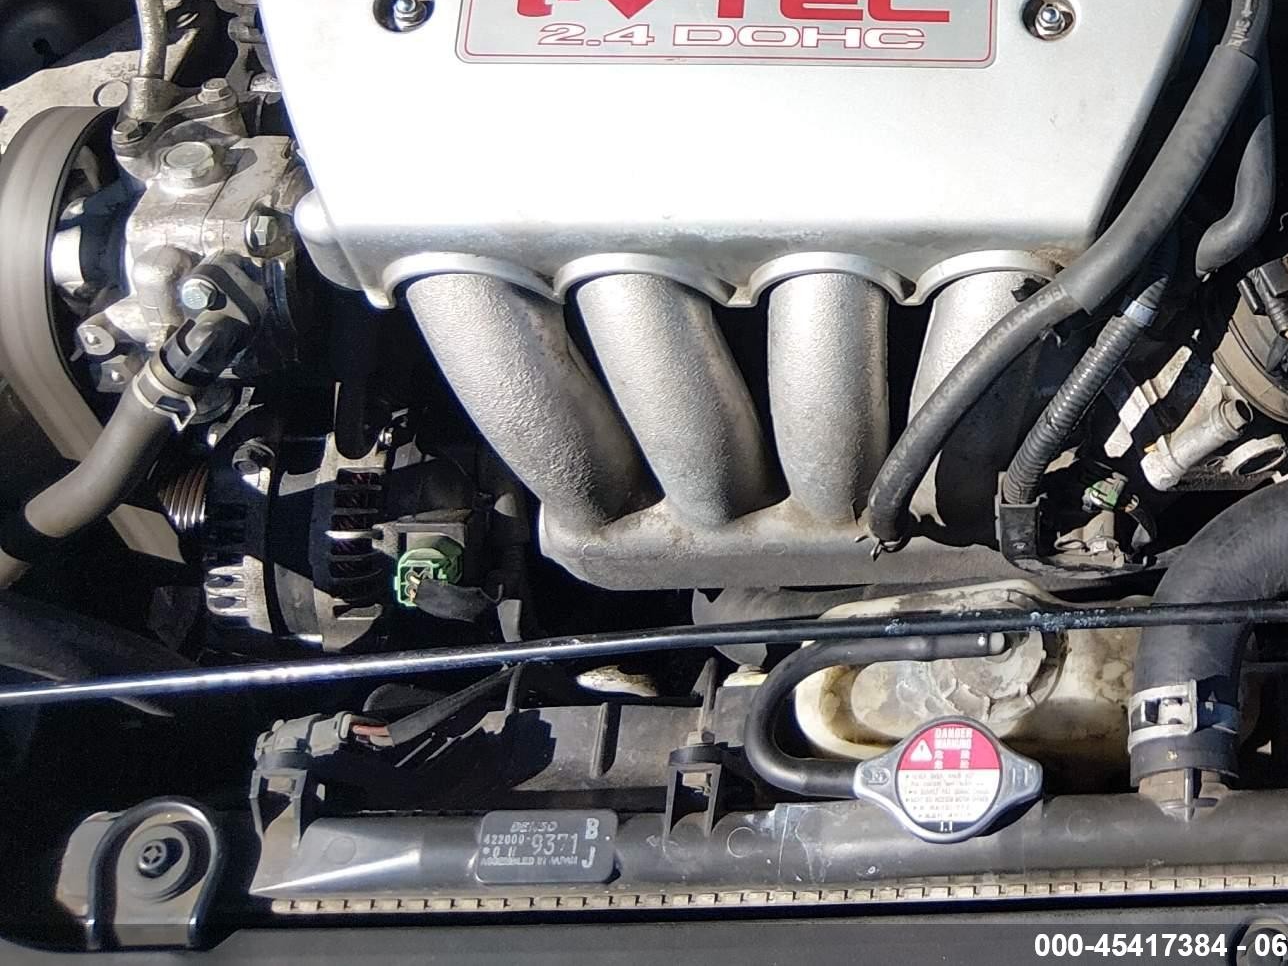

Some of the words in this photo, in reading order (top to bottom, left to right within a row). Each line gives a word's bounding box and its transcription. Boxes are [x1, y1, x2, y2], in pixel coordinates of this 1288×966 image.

[538, 23, 655, 47] 2.4
[672, 24, 925, 49] DOHC
[935, 727, 973, 739] DANGER
[510, 821, 558, 833] DENSO
[585, 817, 600, 840] B
[940, 821, 953, 833] 1.1
[480, 856, 535, 866] ASSEMBLED
[581, 845, 596, 869] J
